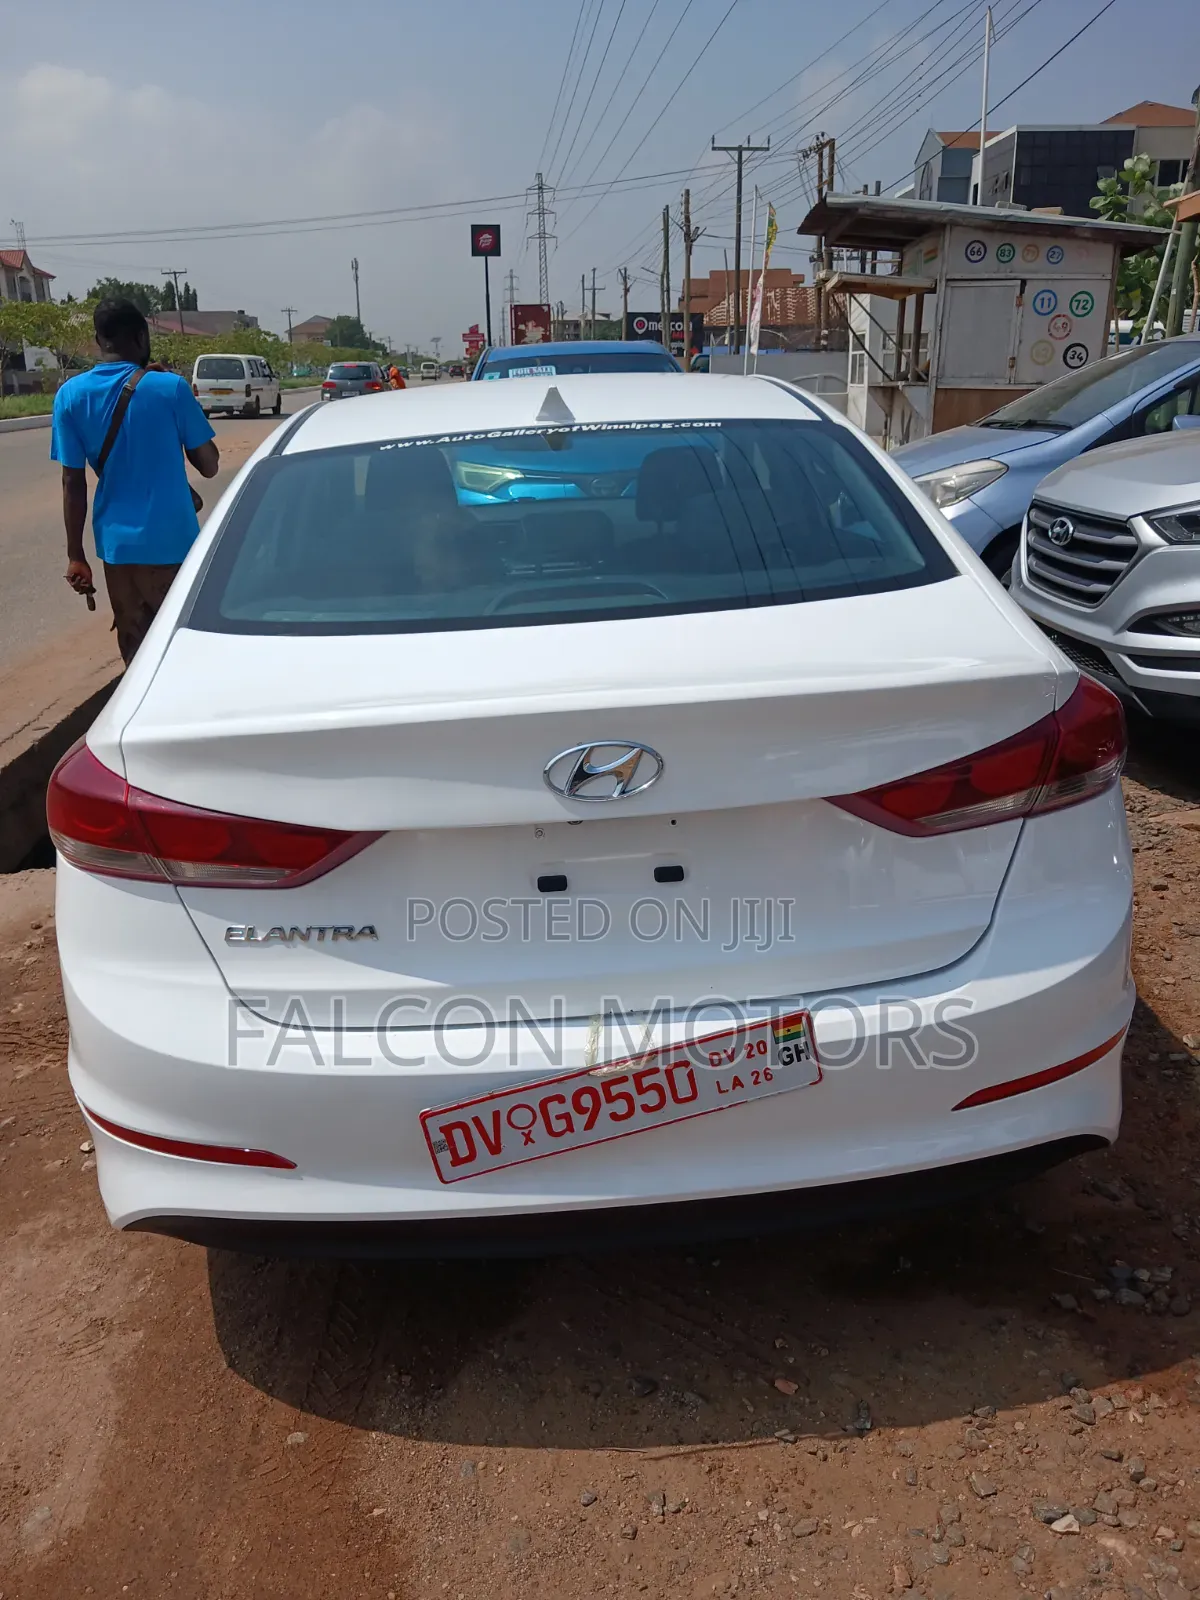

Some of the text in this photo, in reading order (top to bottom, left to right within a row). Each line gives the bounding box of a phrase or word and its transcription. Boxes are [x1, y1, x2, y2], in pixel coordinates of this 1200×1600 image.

[969, 246, 982, 257] 66
[1000, 248, 1011, 258] 83
[1050, 250, 1061, 259] 27
[1040, 297, 1089, 311] 11 72
[1070, 350, 1083, 363] 34
[379, 422, 721, 450] www.AutoGalleryofWinnipeg.com
[224, 924, 380, 942] ELANTRA
[708, 1039, 768, 1067] DV 20
[778, 1041, 811, 1066] GH
[716, 1066, 774, 1095] LA 26
[439, 1109, 502, 1167] DV
